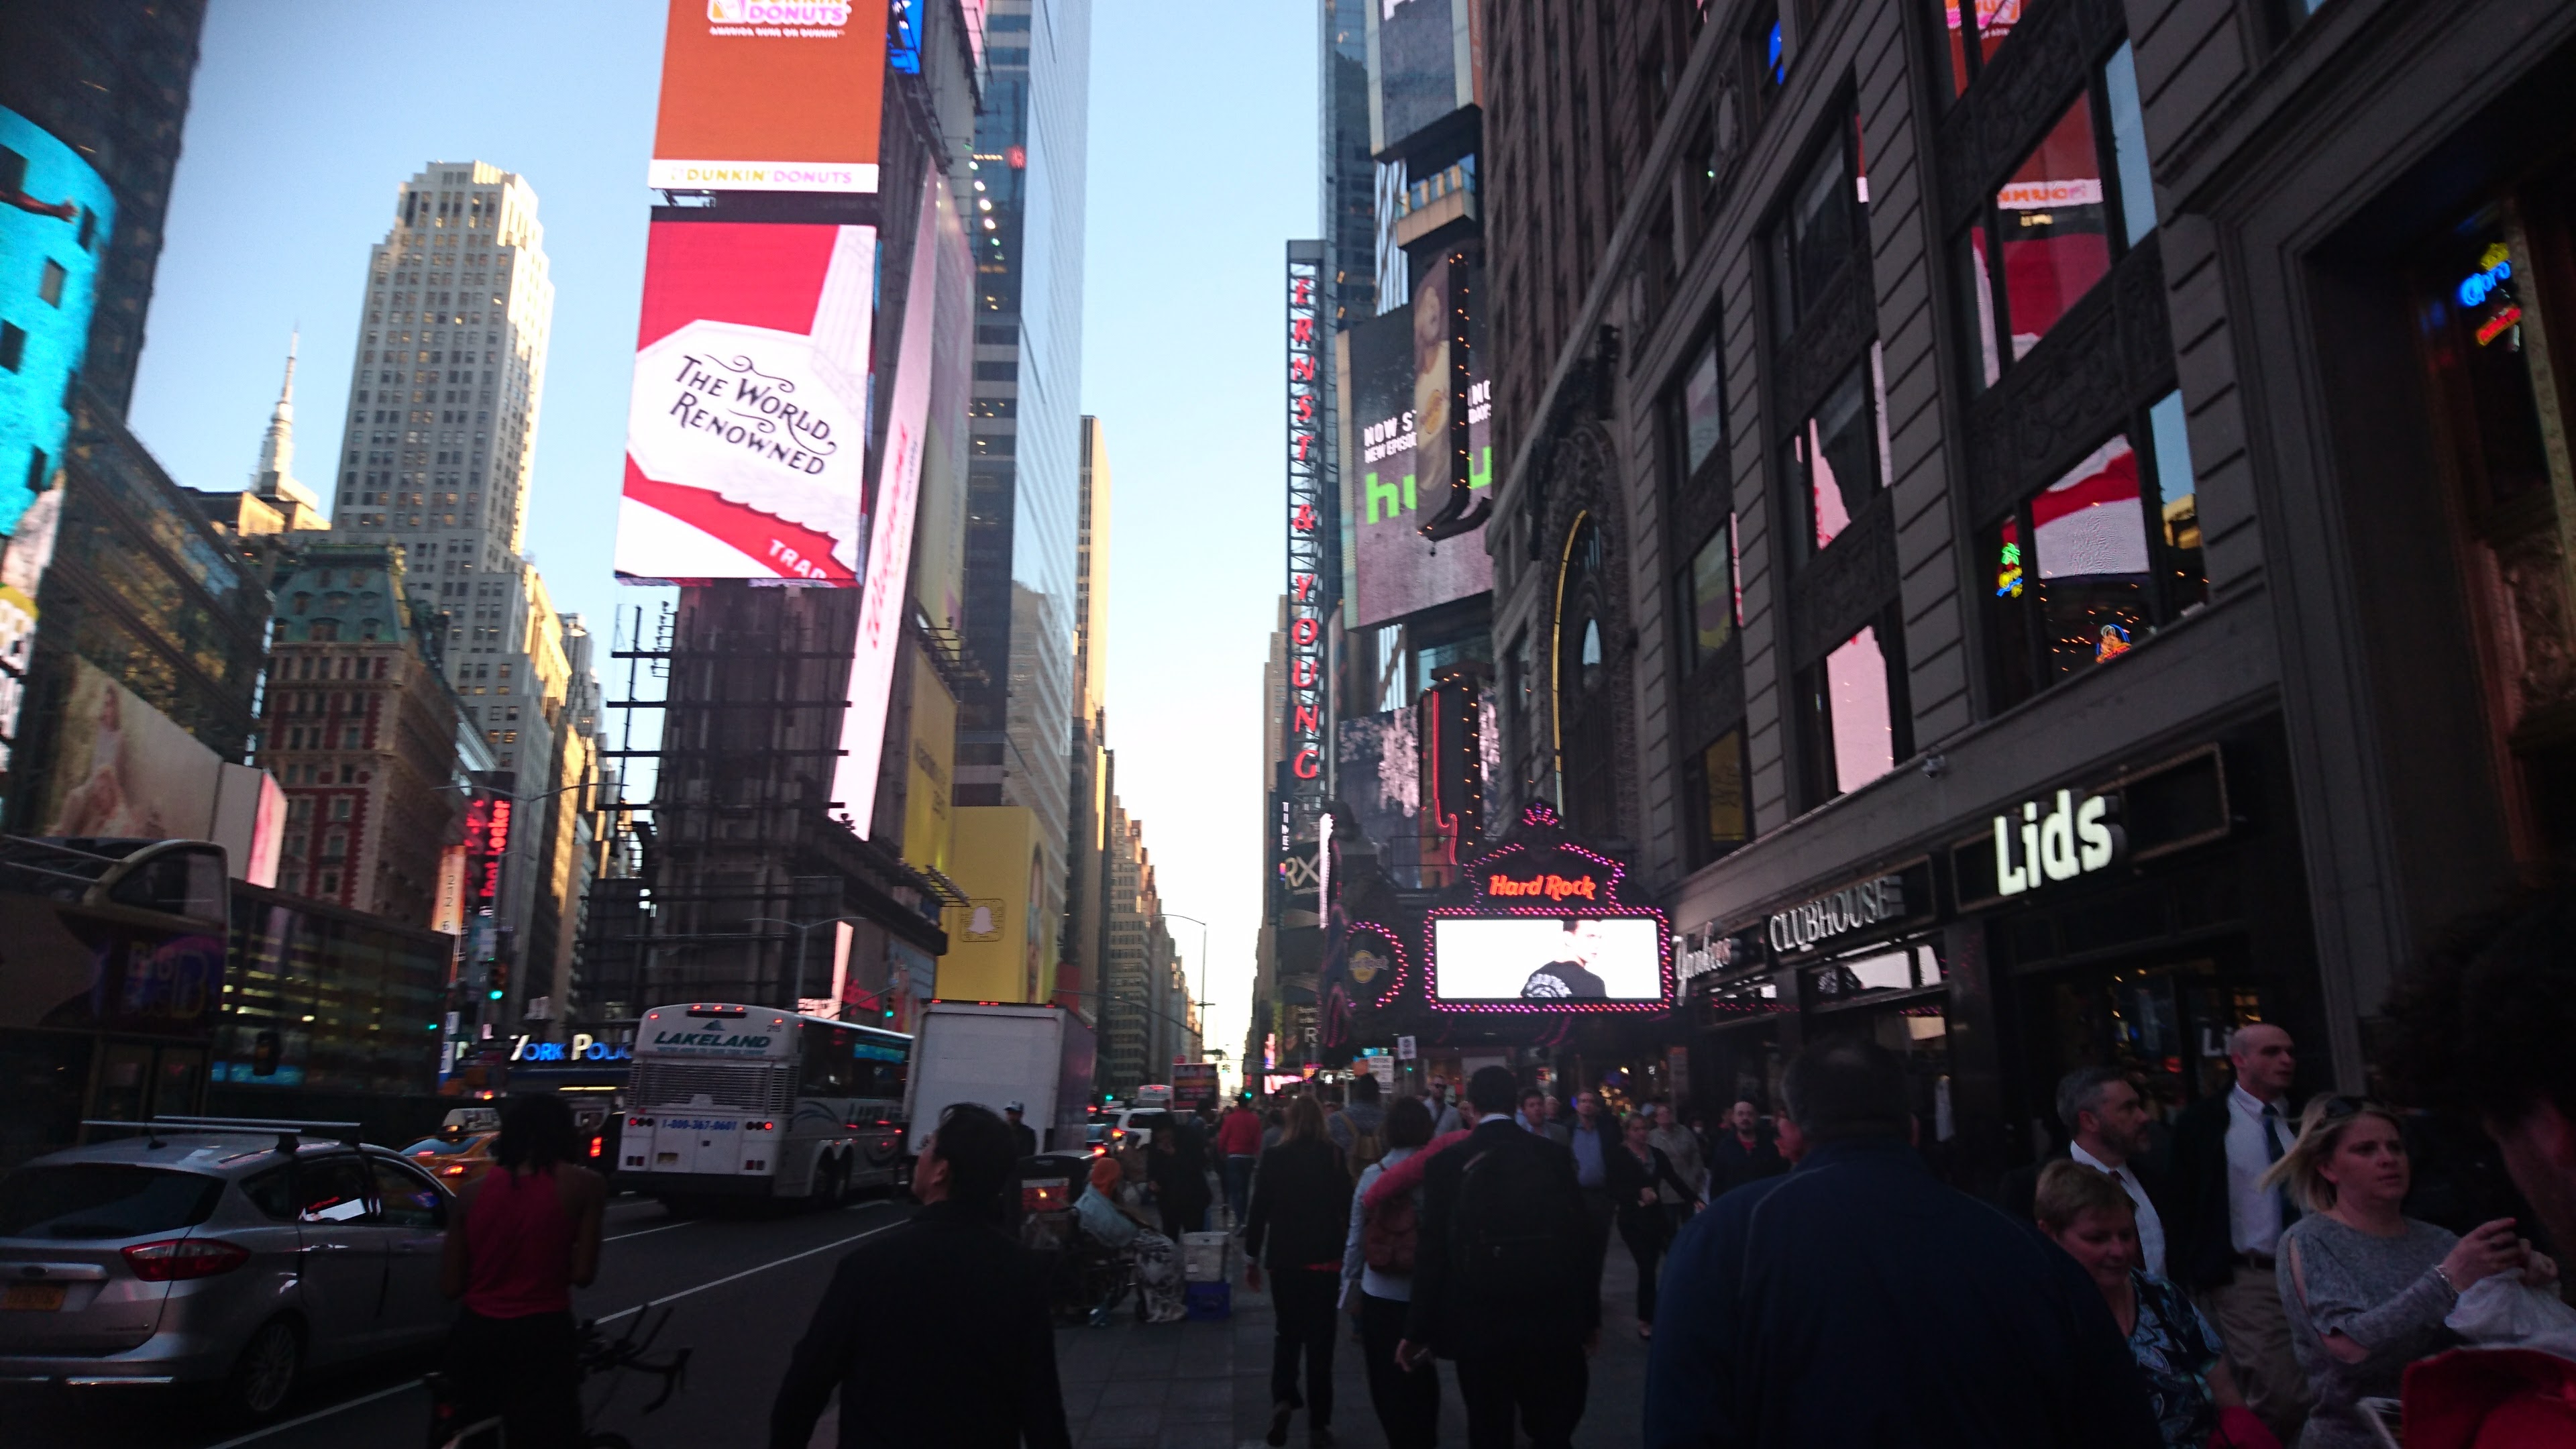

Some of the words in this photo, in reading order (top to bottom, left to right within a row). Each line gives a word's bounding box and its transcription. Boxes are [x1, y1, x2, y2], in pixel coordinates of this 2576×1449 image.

[749, 5, 843, 21] DONUTS
[773, 171, 852, 184] DONUTS
[1293, 279, 1315, 460] ERNST
[676, 355, 729, 397] THE
[736, 378, 837, 452] WORLD,
[669, 391, 826, 476] RENOWNED
[1364, 417, 1397, 447] NOW
[1364, 443, 1386, 464] NEW
[1293, 504, 1316, 529] &
[1292, 575, 1318, 778] YOUNG
[1994, 789, 2114, 896] Lids
[1490, 874, 1544, 896] Hard
[1545, 874, 1597, 902] Rock
[1770, 877, 1898, 953] CLUBHOUSE
[508, 1034, 568, 1061] YORK
[654, 1030, 771, 1049] LAKELAND
